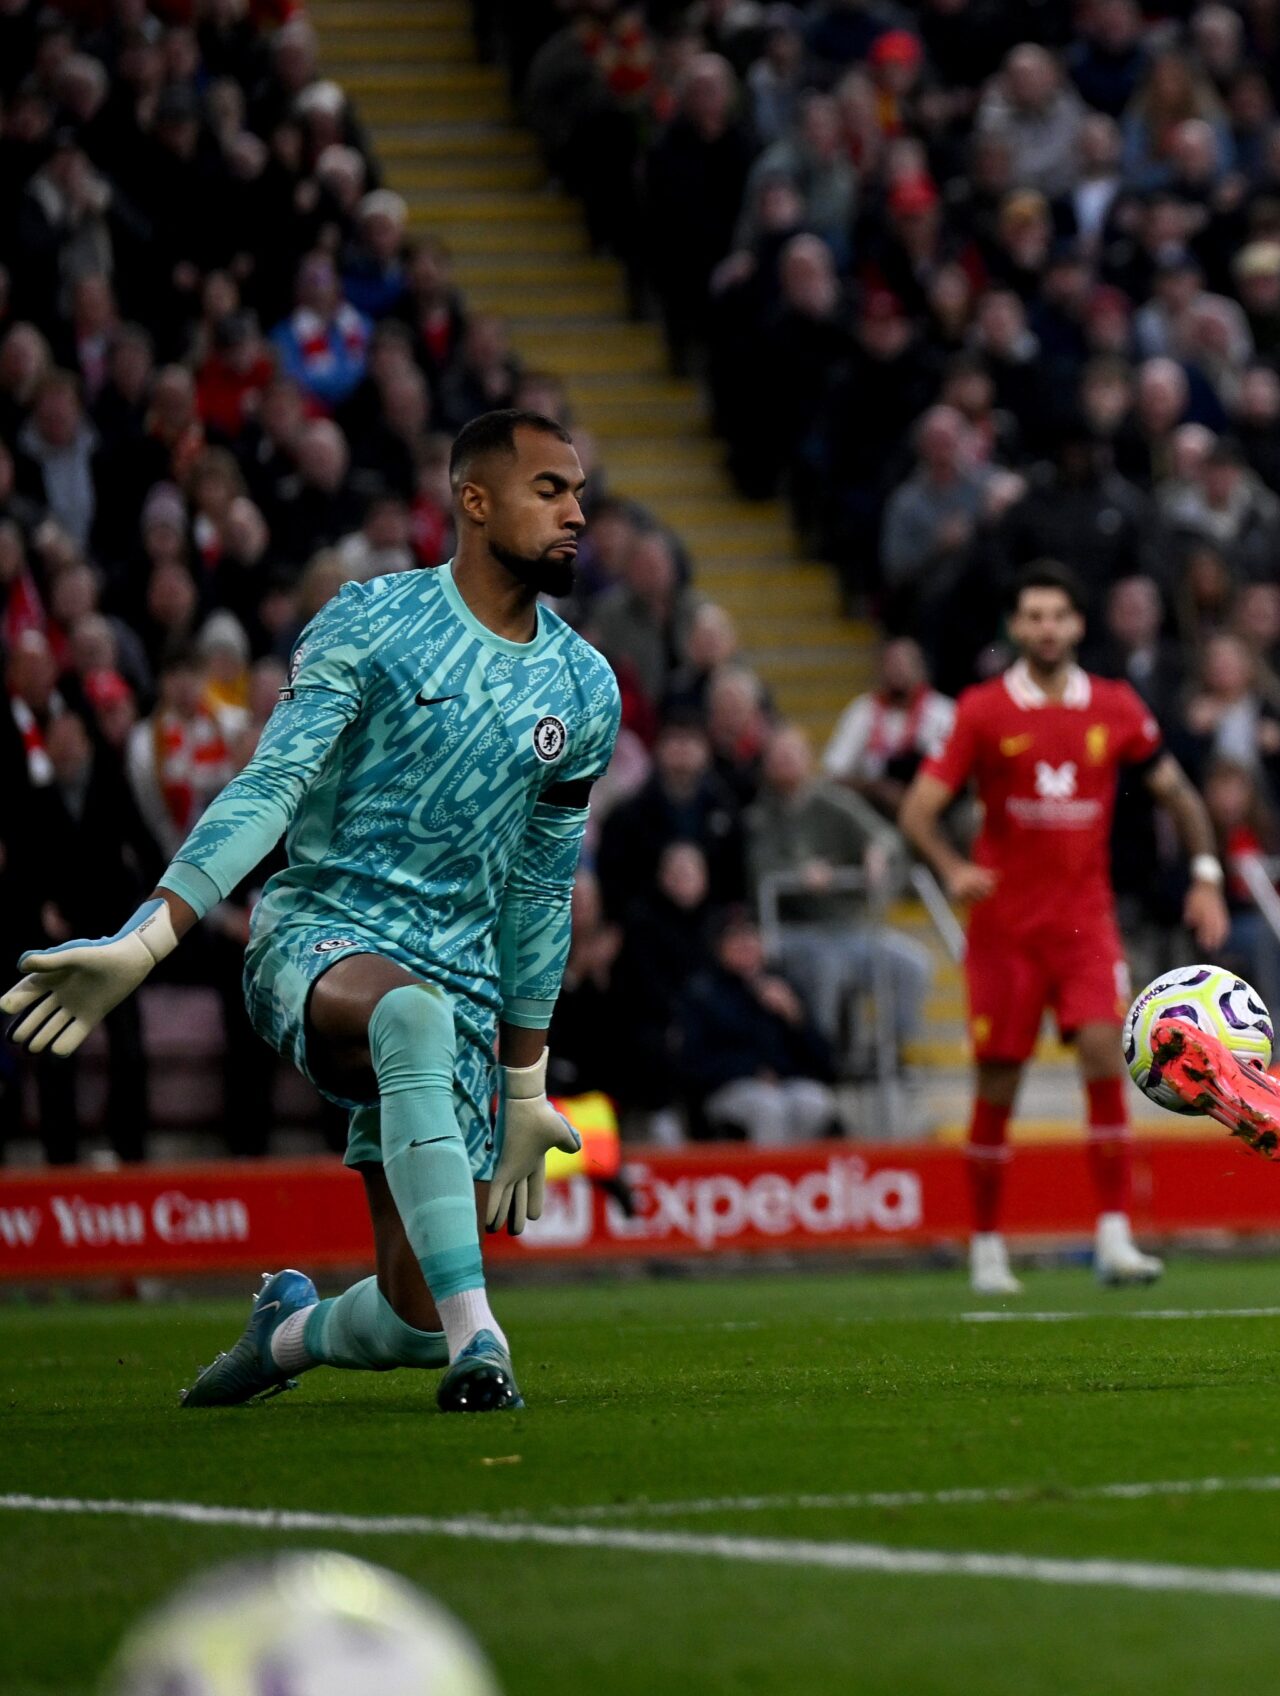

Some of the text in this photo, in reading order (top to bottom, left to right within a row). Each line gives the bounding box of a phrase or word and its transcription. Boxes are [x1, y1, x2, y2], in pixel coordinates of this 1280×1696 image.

[51, 1196, 145, 1247] You
[152, 1190, 249, 1245] Can
[606, 1157, 922, 1248] Expedia
